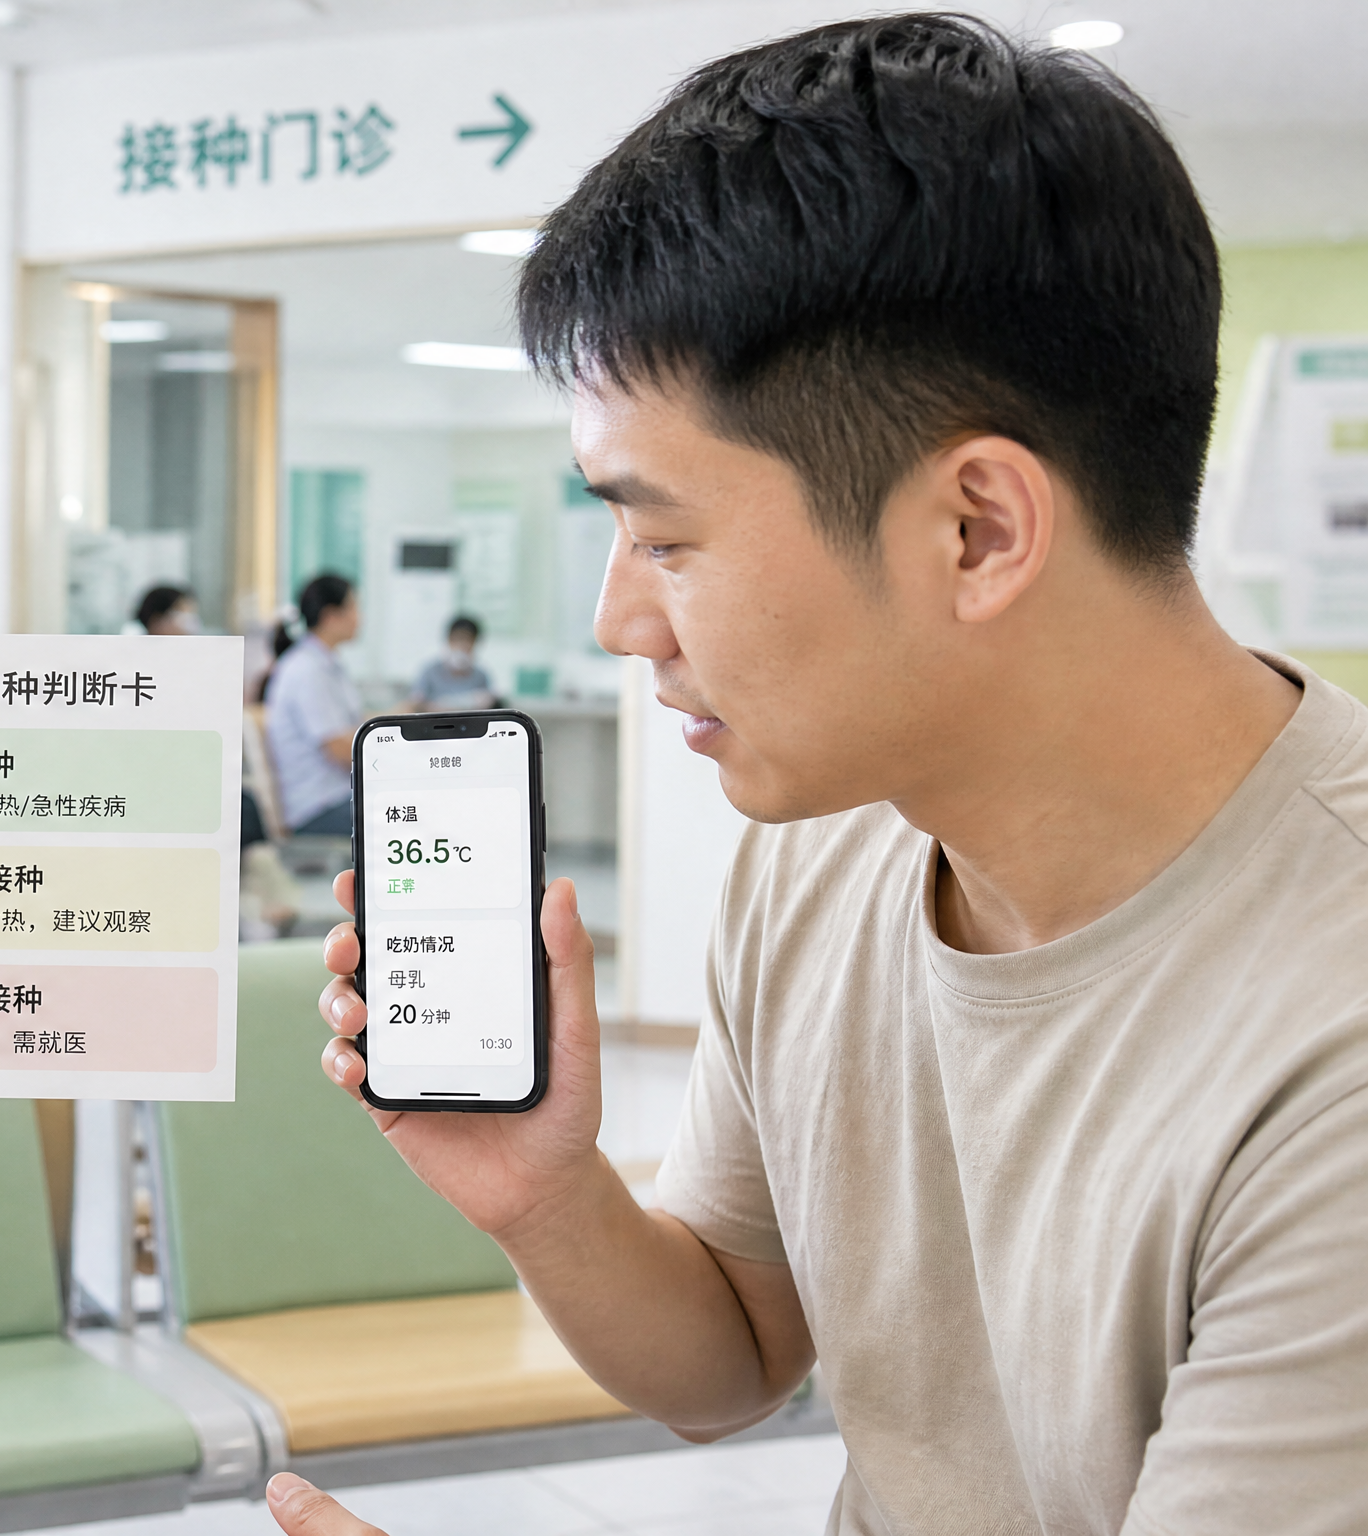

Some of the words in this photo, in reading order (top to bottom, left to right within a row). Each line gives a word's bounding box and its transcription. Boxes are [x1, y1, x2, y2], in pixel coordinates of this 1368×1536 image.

[117, 102, 397, 195] 接种门诊
[385, 805, 419, 824] 体温
[386, 935, 455, 954] 吃奶情况
[479, 1037, 513, 1050] 10:30
